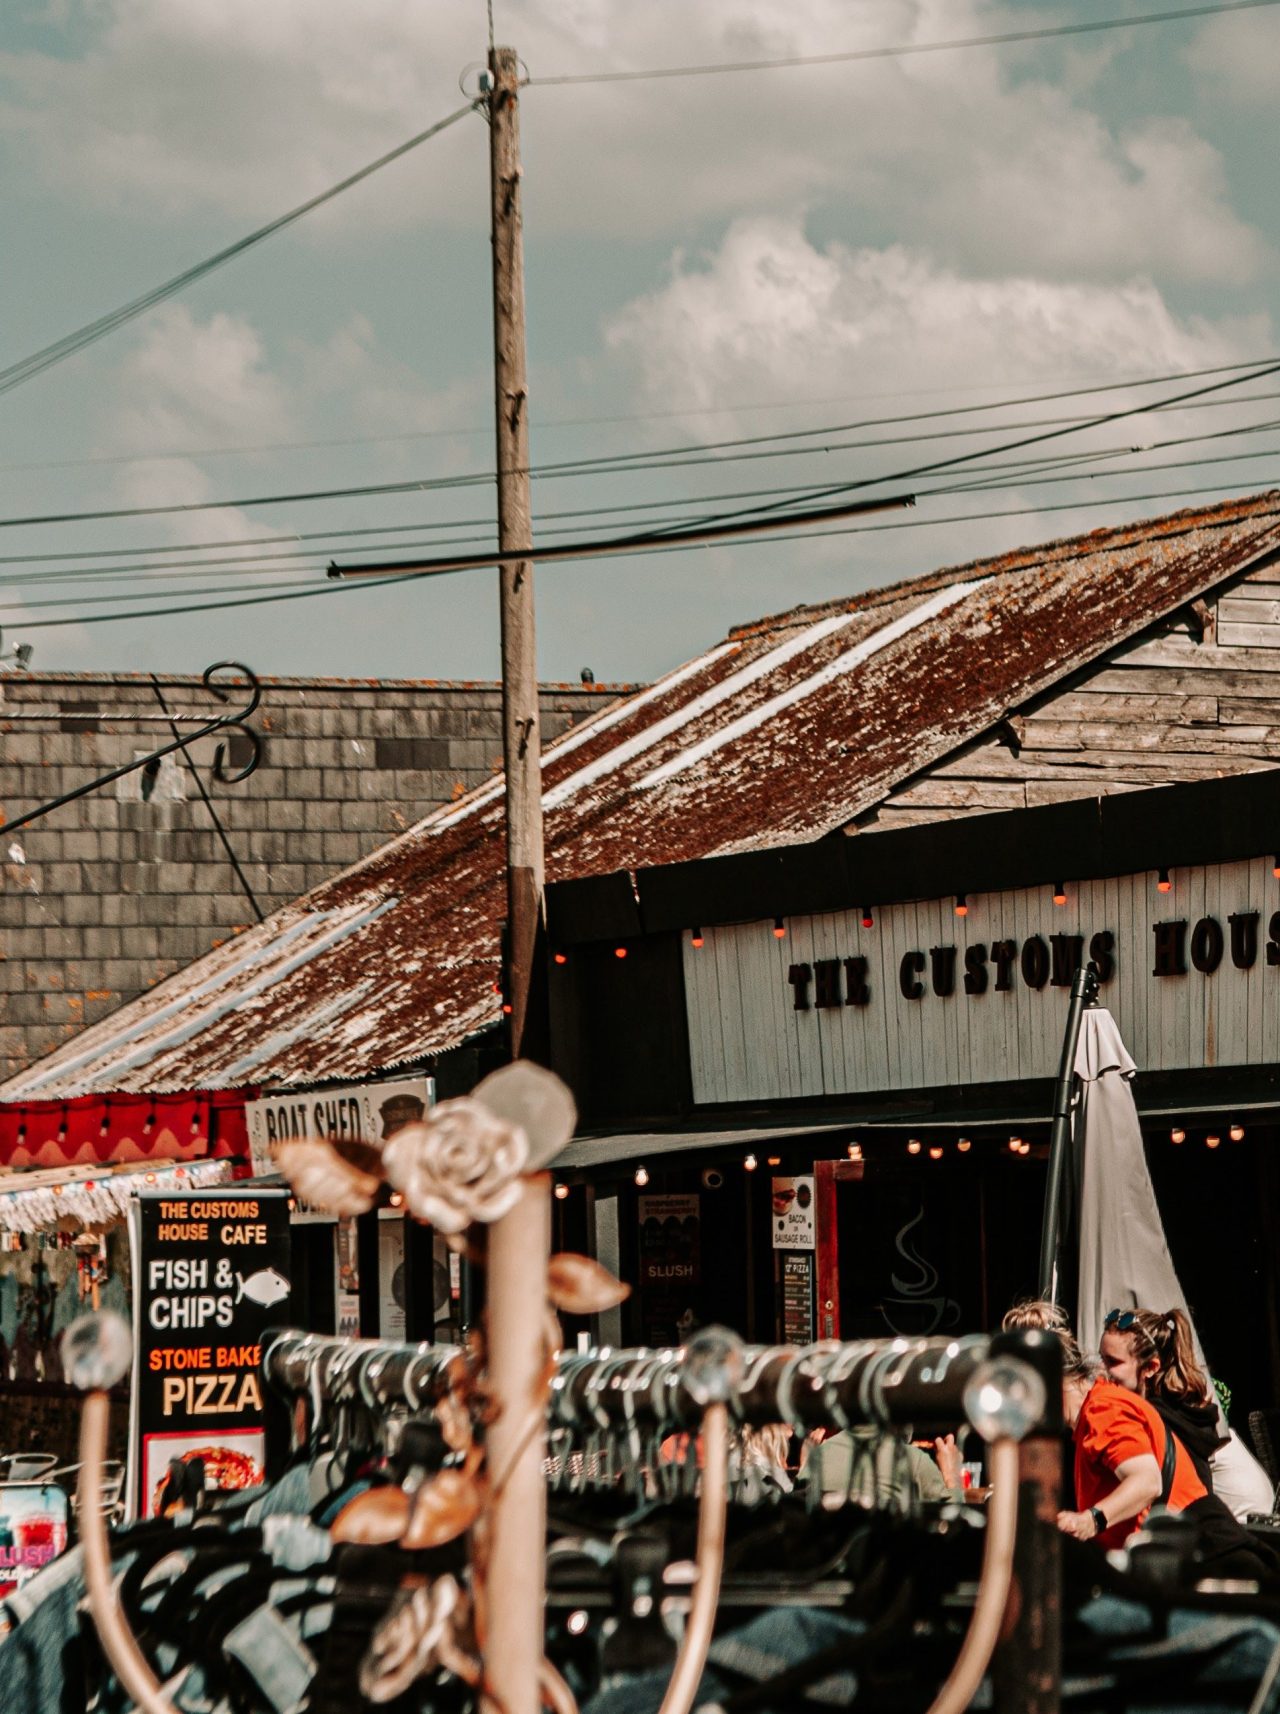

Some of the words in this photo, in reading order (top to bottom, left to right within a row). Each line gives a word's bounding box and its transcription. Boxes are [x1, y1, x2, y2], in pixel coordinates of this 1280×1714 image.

[789, 956, 871, 1010] THE
[900, 931, 1115, 1000] CUSTOMS
[265, 1103, 308, 1143] BOAT
[159, 1202, 188, 1218] THE
[190, 1202, 259, 1219] CUSTOMS
[158, 1224, 208, 1241] HOUSE
[220, 1225, 267, 1245] CAFE
[149, 1259, 208, 1290] FISH
[214, 1258, 233, 1288] &
[648, 1265, 693, 1277] SLUSH
[149, 1296, 233, 1330] CHIPS
[149, 1347, 212, 1370] STONE
[216, 1345, 262, 1367] BAKE
[163, 1373, 263, 1416] PIZZA
[0, 1544, 55, 1569] LUSH
